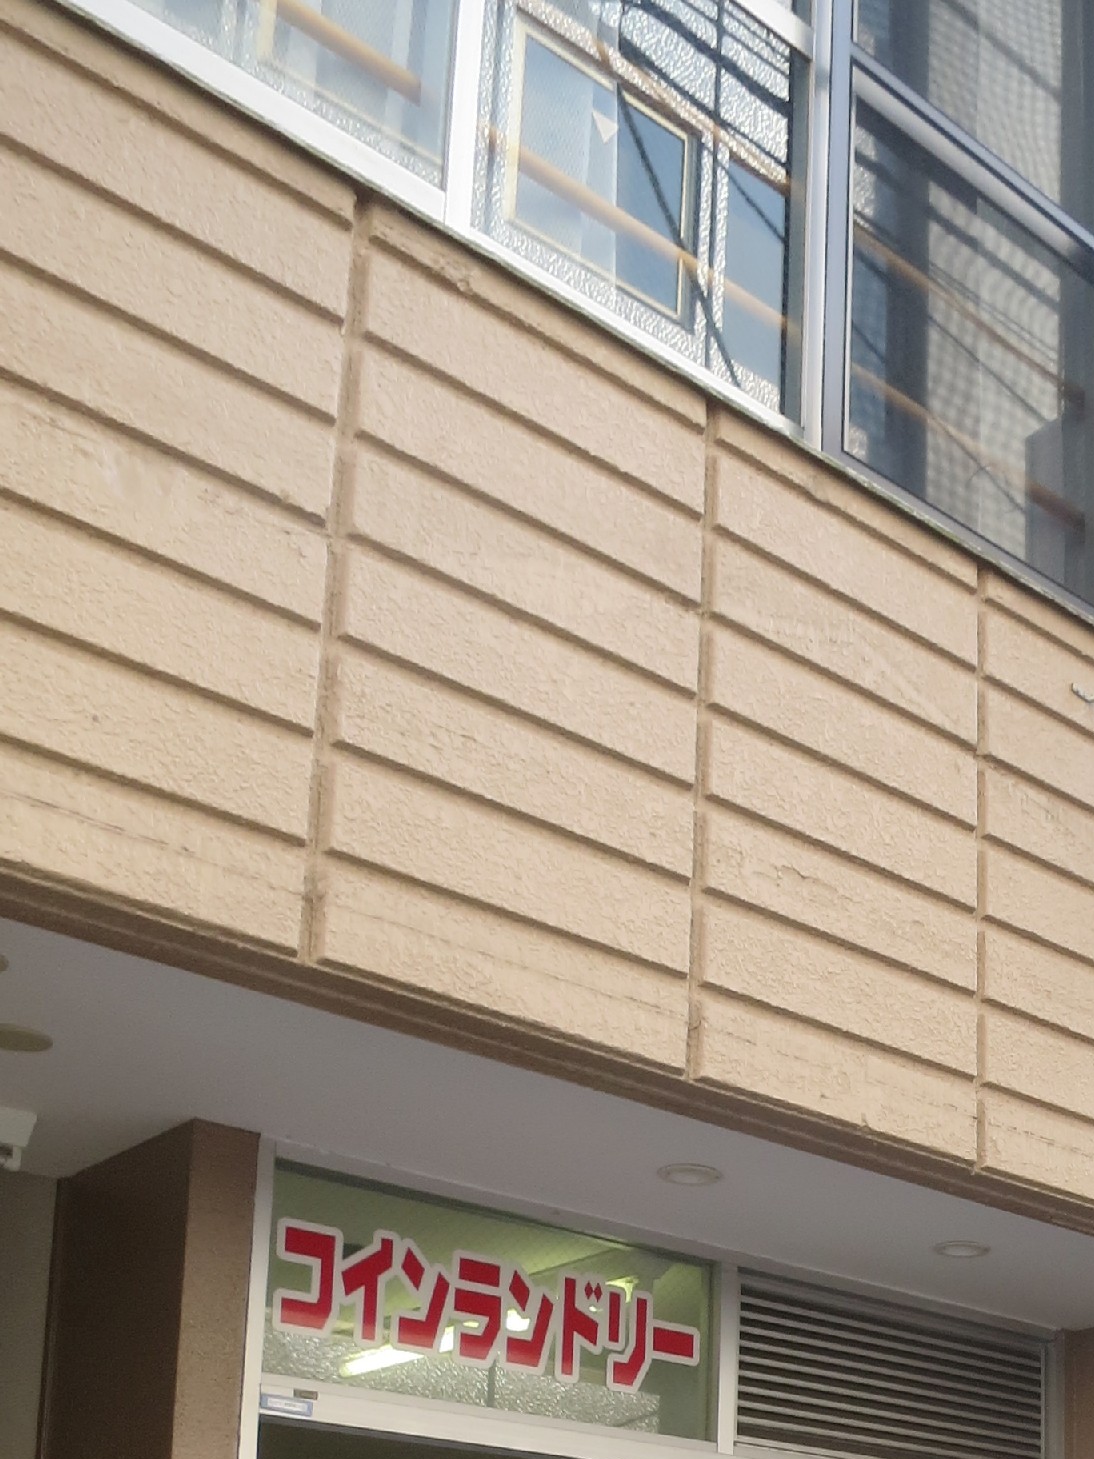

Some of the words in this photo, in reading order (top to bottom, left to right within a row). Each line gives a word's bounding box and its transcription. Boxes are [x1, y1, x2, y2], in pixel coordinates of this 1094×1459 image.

[273, 1217, 700, 1392] コインランドリー
